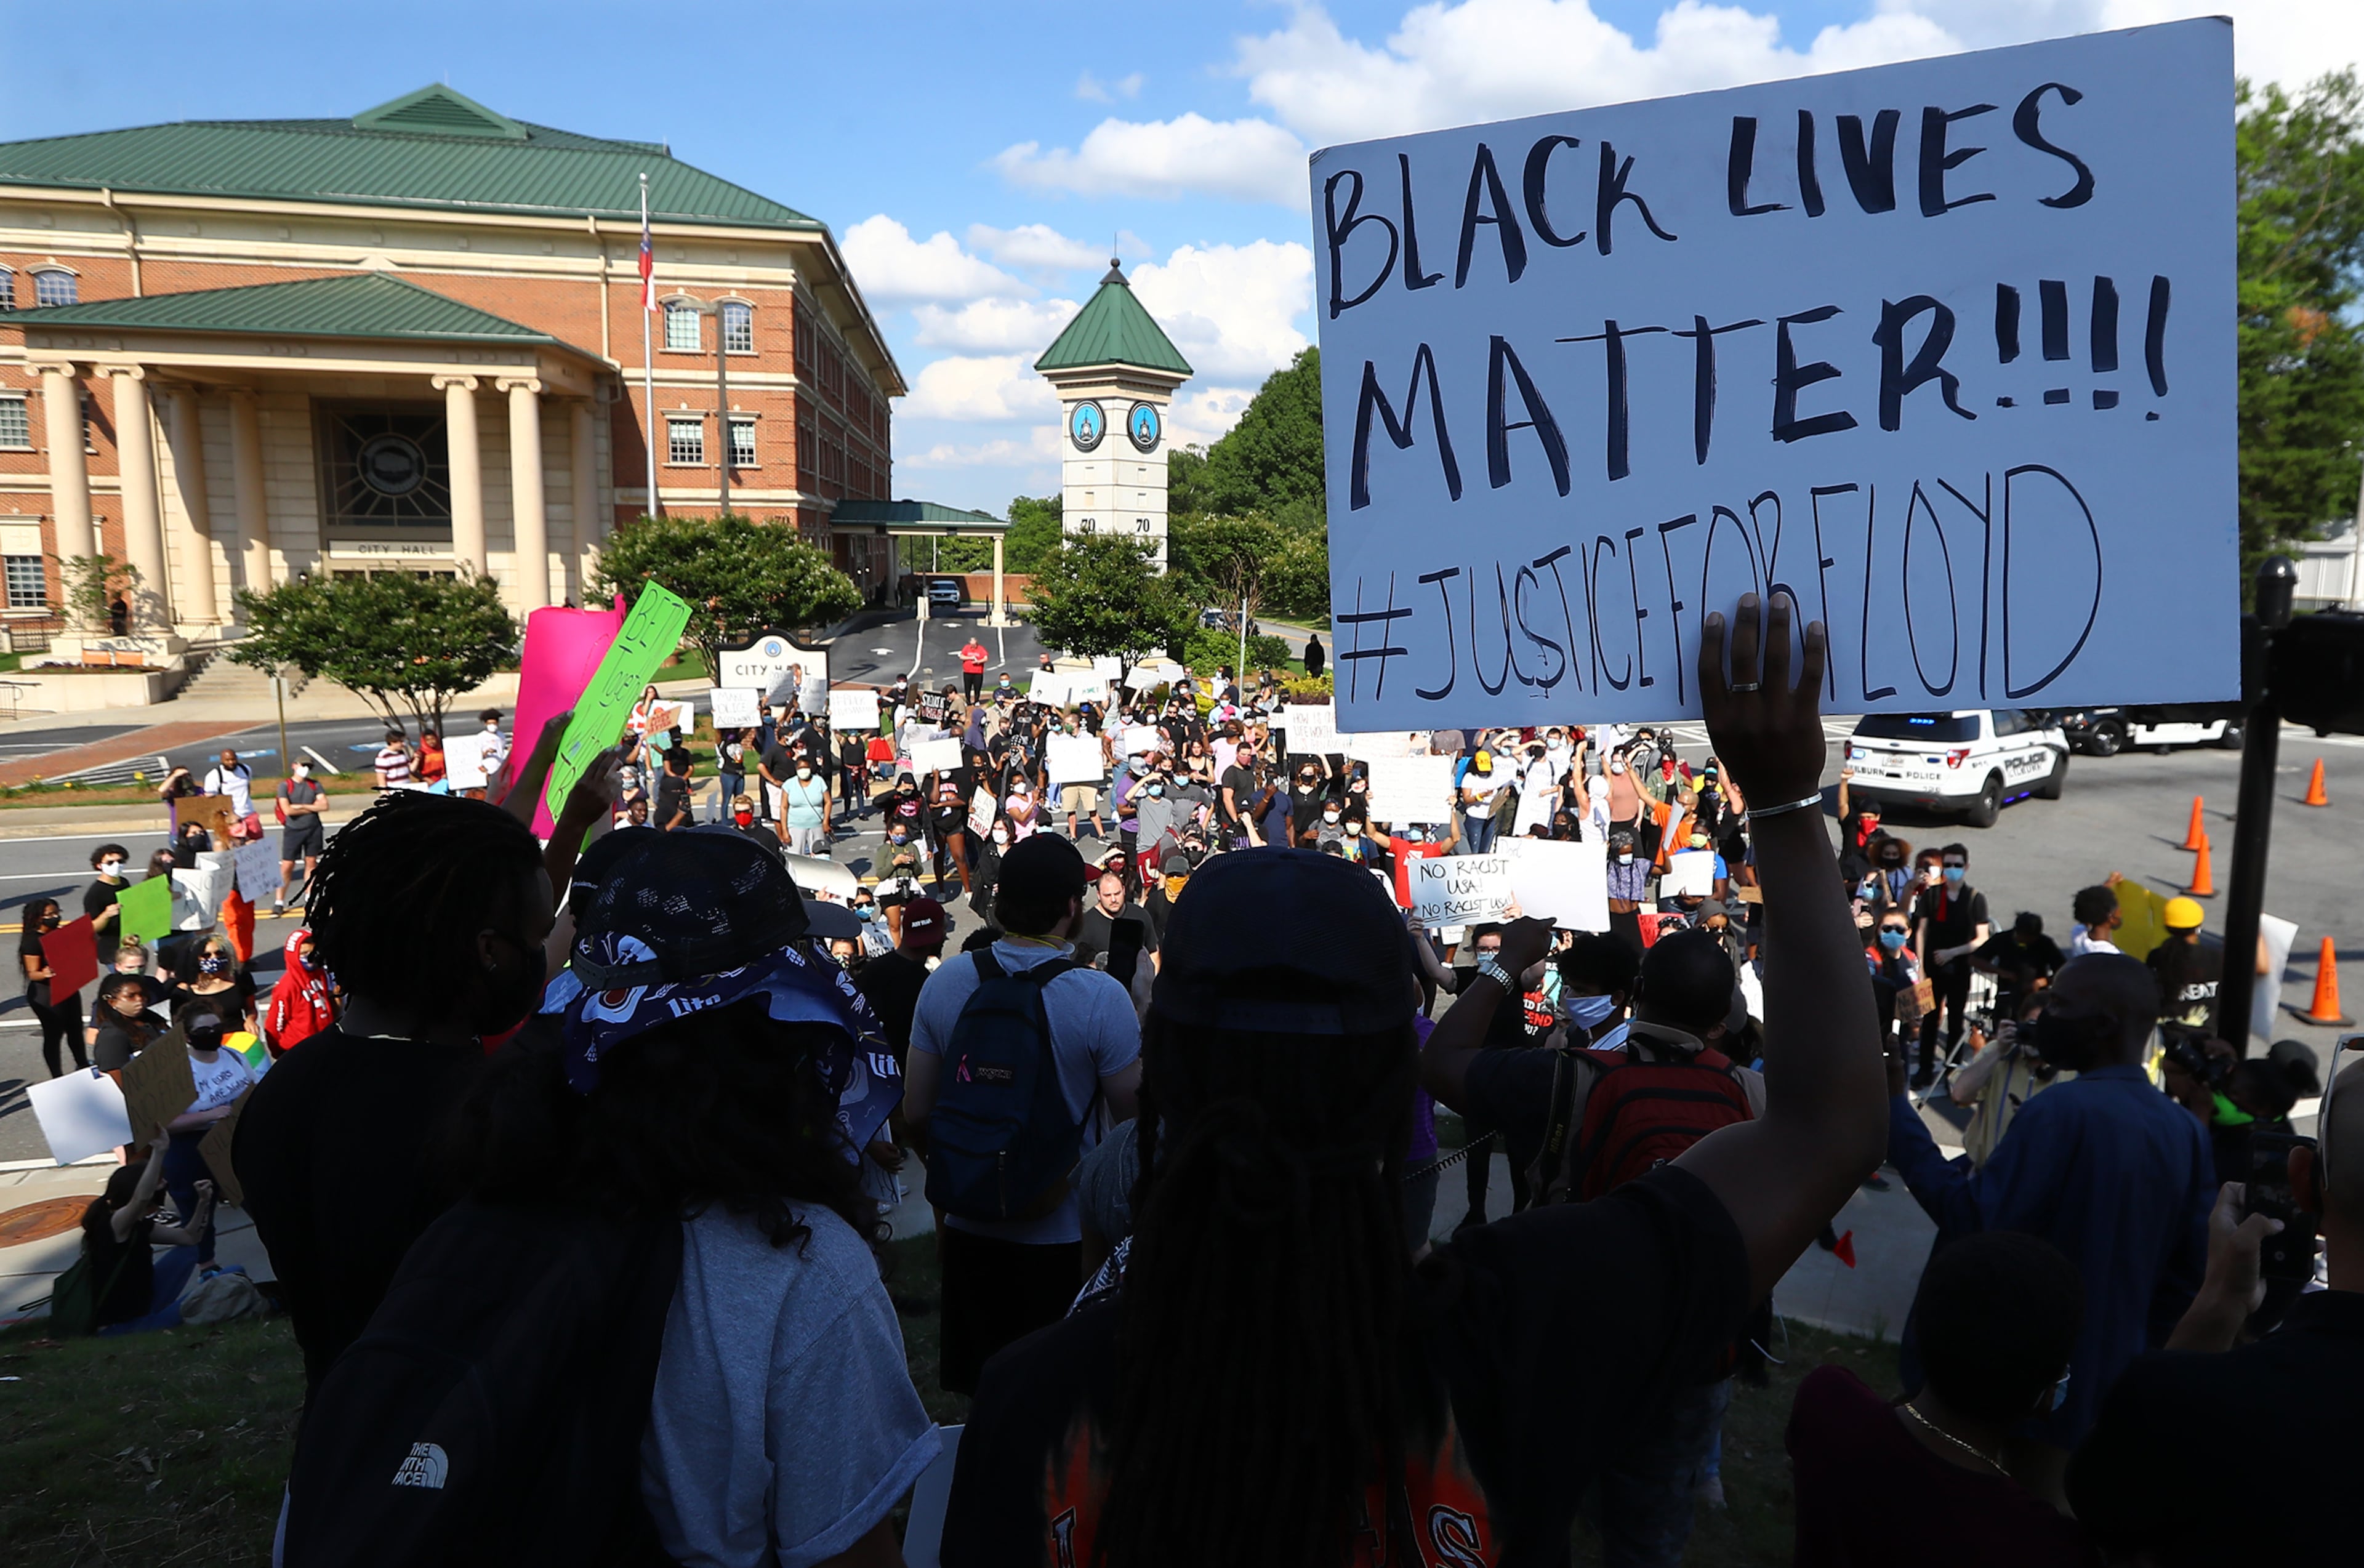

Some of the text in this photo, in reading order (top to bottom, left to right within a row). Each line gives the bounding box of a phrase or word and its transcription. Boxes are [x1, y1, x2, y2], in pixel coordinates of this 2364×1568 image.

[1324, 82, 2094, 320] BLACK LIVES
[1349, 275, 2170, 510] MATTER!!!!
[1136, 518, 1150, 533] 70
[358, 544, 436, 554] CITY HALL
[1336, 464, 2104, 706] #JUSTICEFORFLOYD
[736, 665, 767, 675] CITY
[1293, 712, 1309, 725] HOW
[1313, 711, 1322, 724] IS
[2004, 750, 2048, 770] POLICE
[1906, 771, 1942, 781] POLICE
[968, 817, 989, 840] THUG
[1420, 859, 1510, 883] NO RACIST
[1422, 903, 1441, 918] NO
[1444, 898, 1488, 916] RACIST
[867, 1051, 901, 1079] Lit
[409, 1442, 430, 1457] THE
